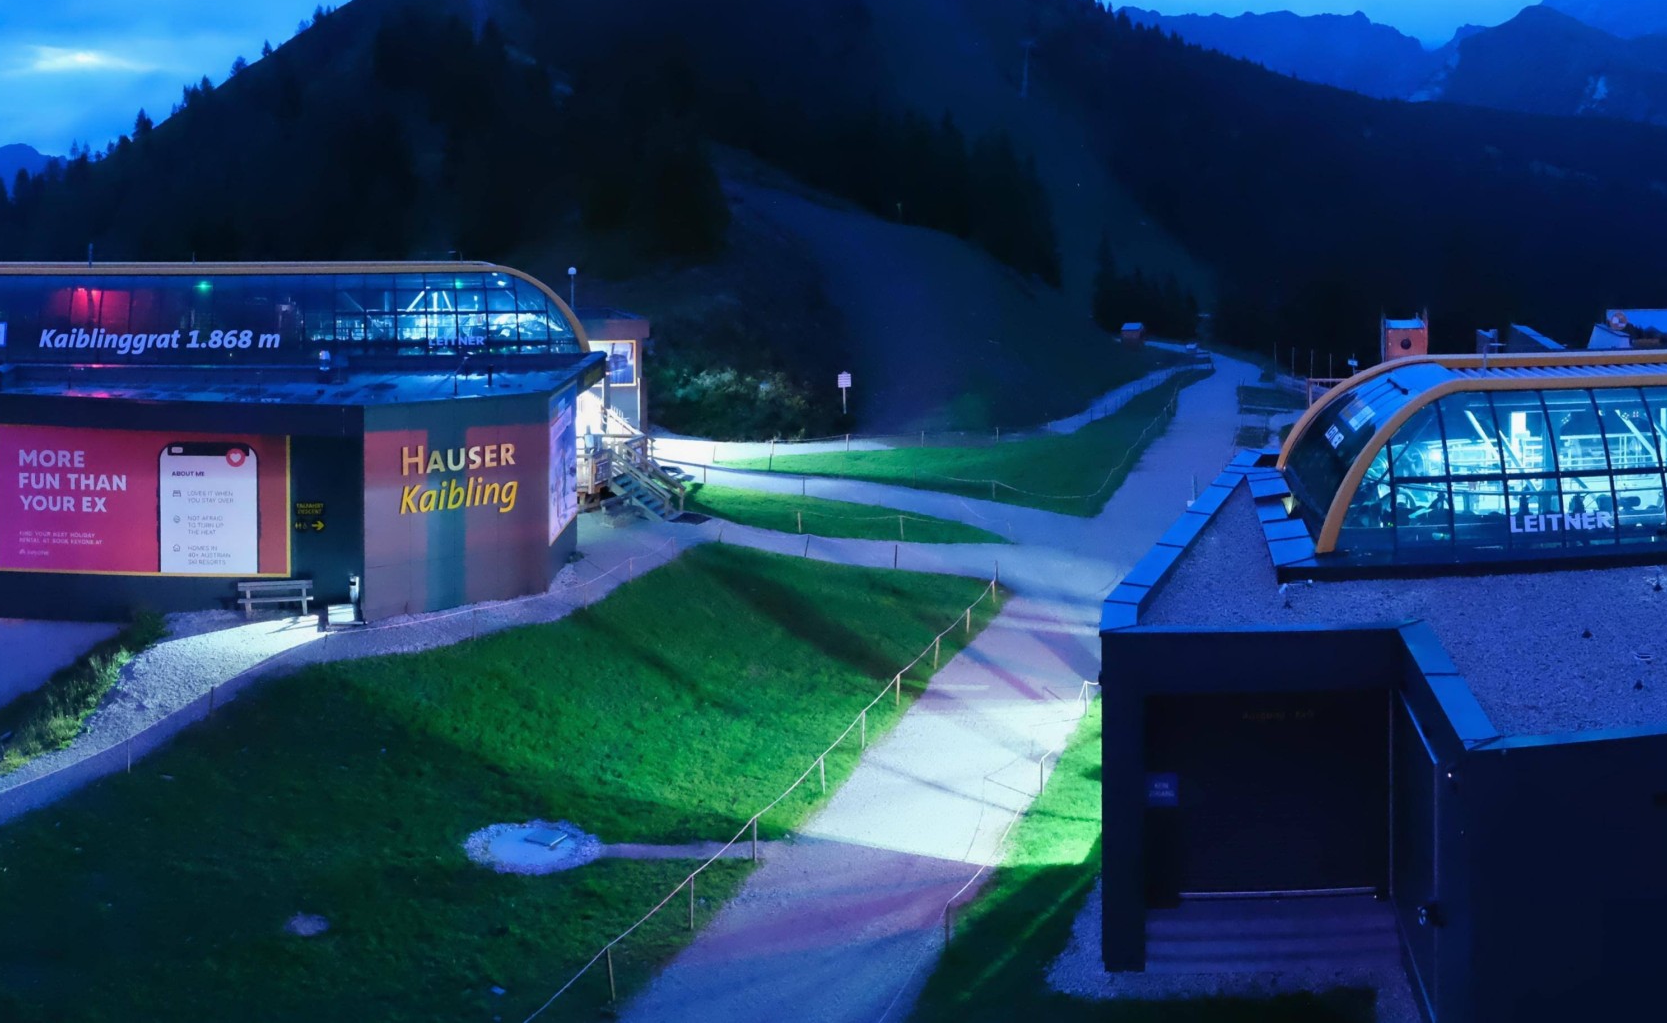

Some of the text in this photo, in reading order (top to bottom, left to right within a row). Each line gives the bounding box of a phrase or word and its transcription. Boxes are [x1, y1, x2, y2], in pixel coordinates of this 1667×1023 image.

[38, 328, 280, 355] Kaiblinggrat 1.868 m
[428, 335, 485, 346] LEITNER
[19, 449, 85, 468] MORE
[402, 442, 516, 476] HAUSER
[19, 472, 127, 491] FUN THAN
[19, 495, 107, 513] YOUR EX
[400, 477, 518, 515] Kaibling
[1509, 511, 1612, 533] LEITNER
